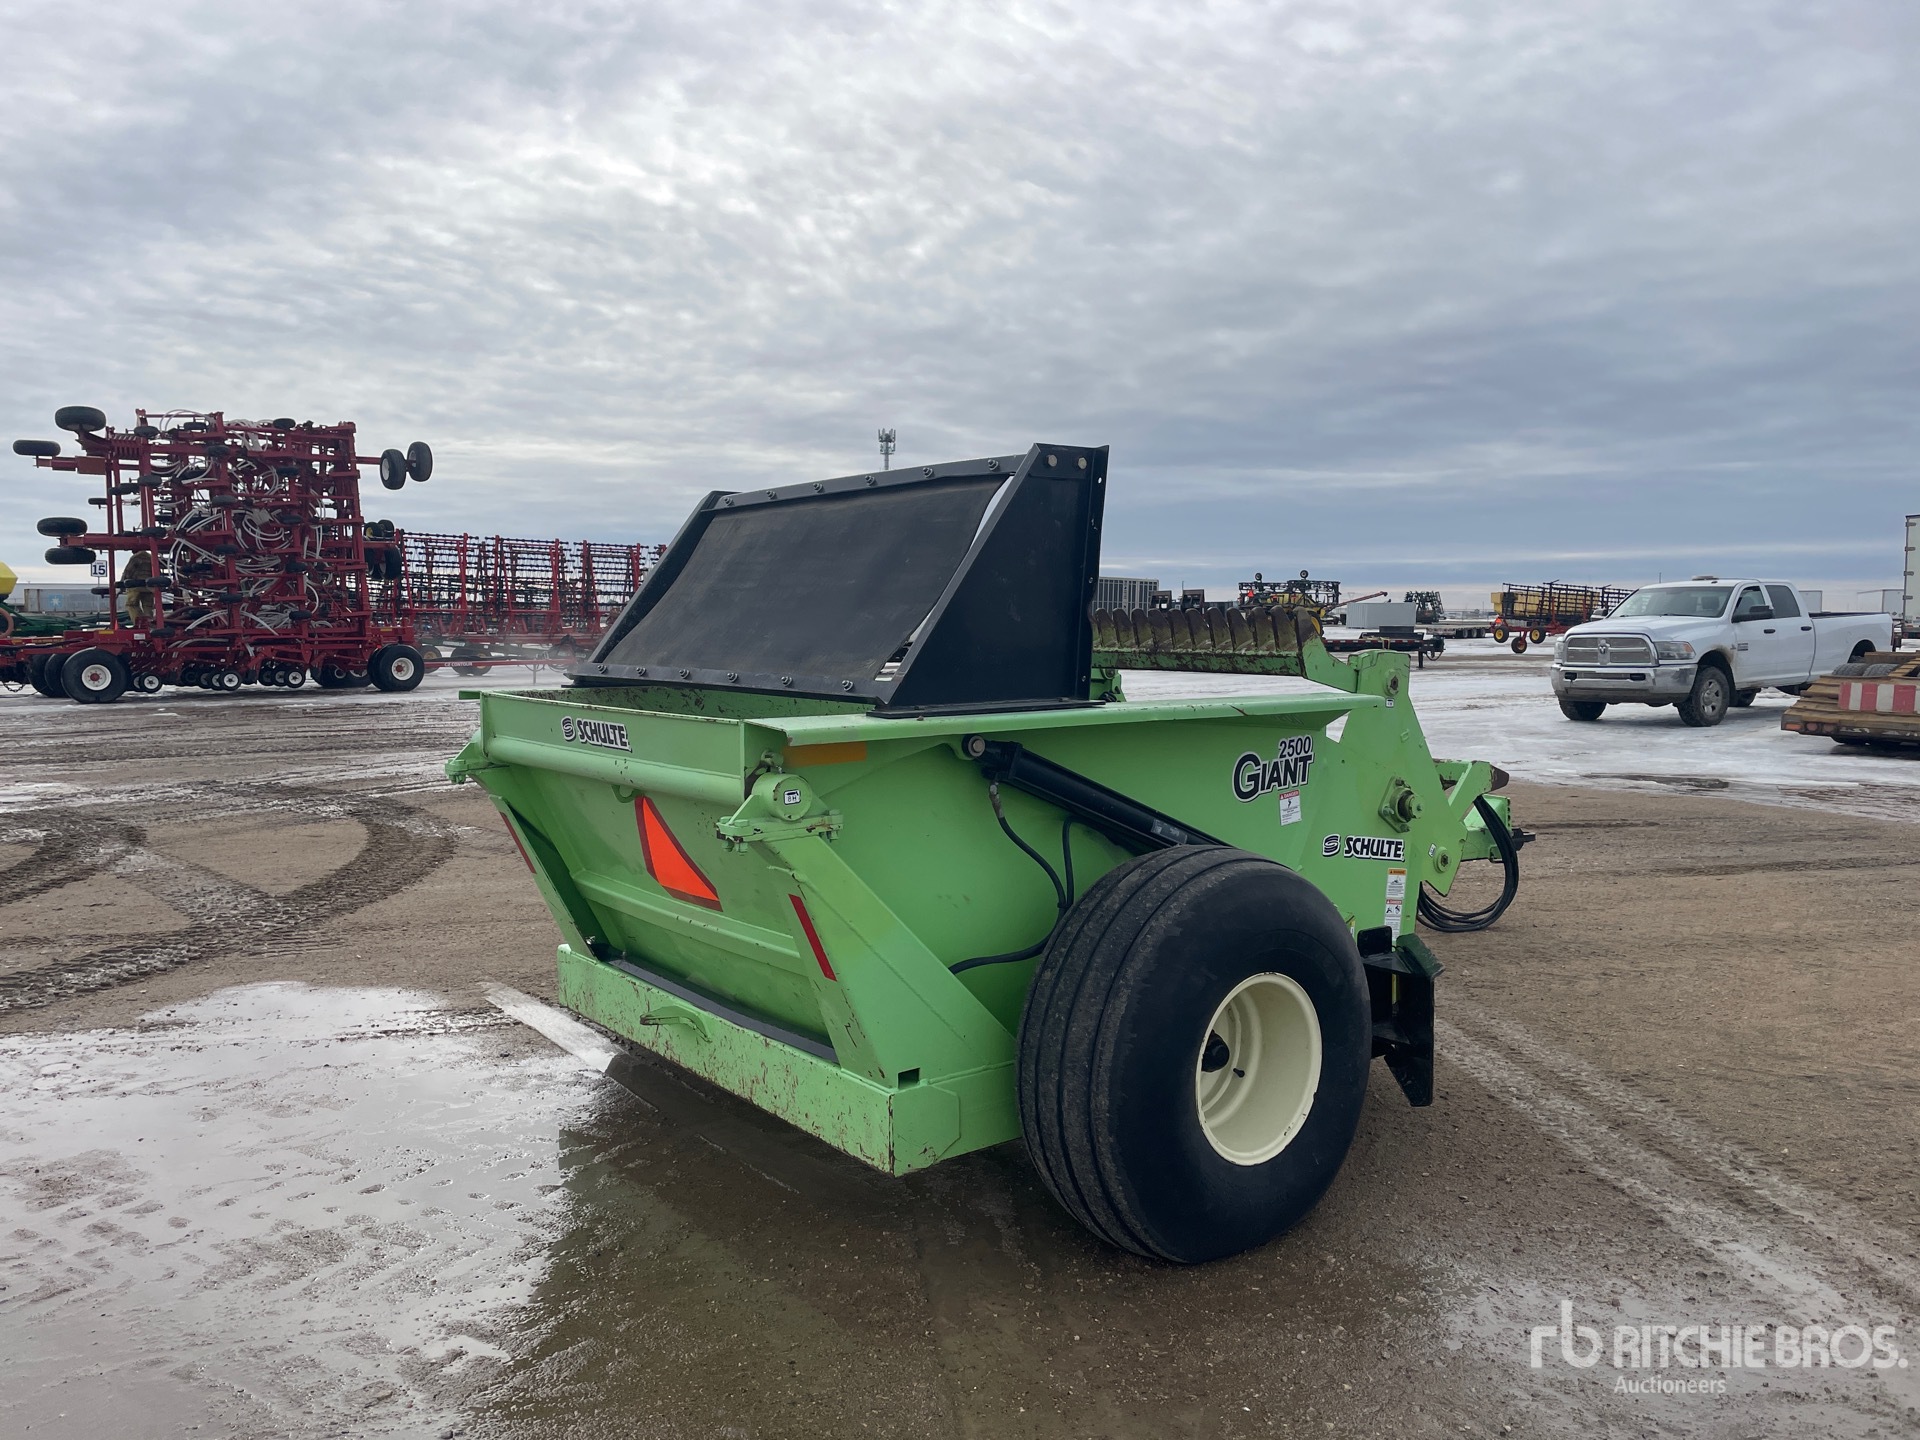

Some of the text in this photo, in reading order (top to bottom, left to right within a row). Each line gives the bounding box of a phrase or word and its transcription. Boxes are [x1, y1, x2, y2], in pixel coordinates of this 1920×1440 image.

[92, 565, 106, 575] 15
[576, 719, 628, 747] SCHULTE
[1279, 736, 1312, 758] 2500
[1233, 753, 1313, 800] GIANT
[1344, 836, 1403, 859] SCHULTE
